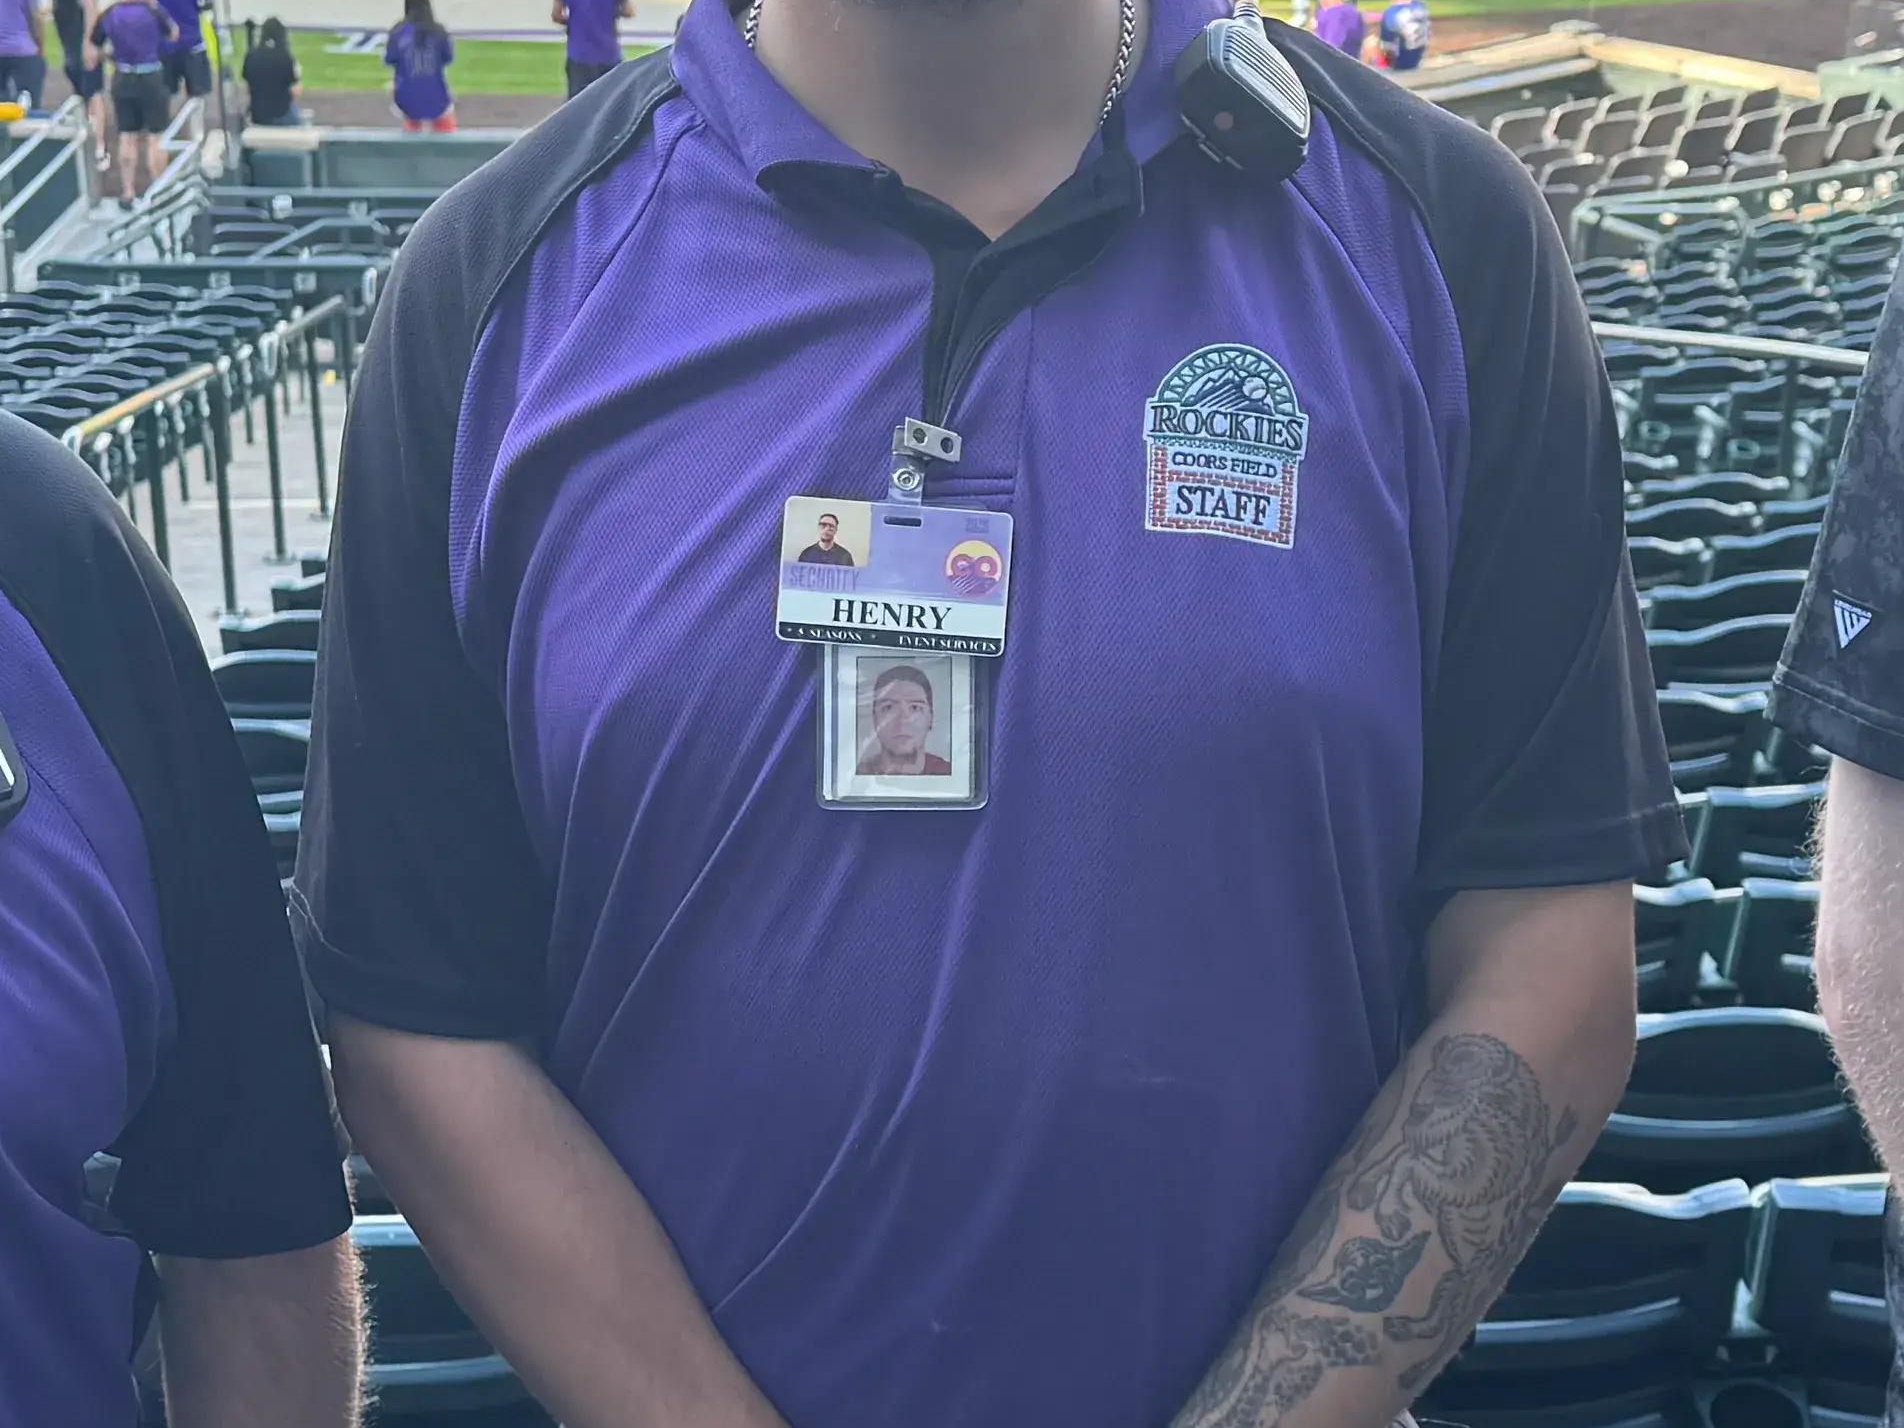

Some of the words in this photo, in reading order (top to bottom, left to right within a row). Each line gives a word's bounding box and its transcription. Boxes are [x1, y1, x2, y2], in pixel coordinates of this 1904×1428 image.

[1150, 404, 1304, 451] ROCKIES
[1172, 451, 1228, 471] COORS
[1230, 458, 1278, 478] FIELD
[1175, 484, 1271, 526] STAFF
[831, 597, 953, 631] HENRY
